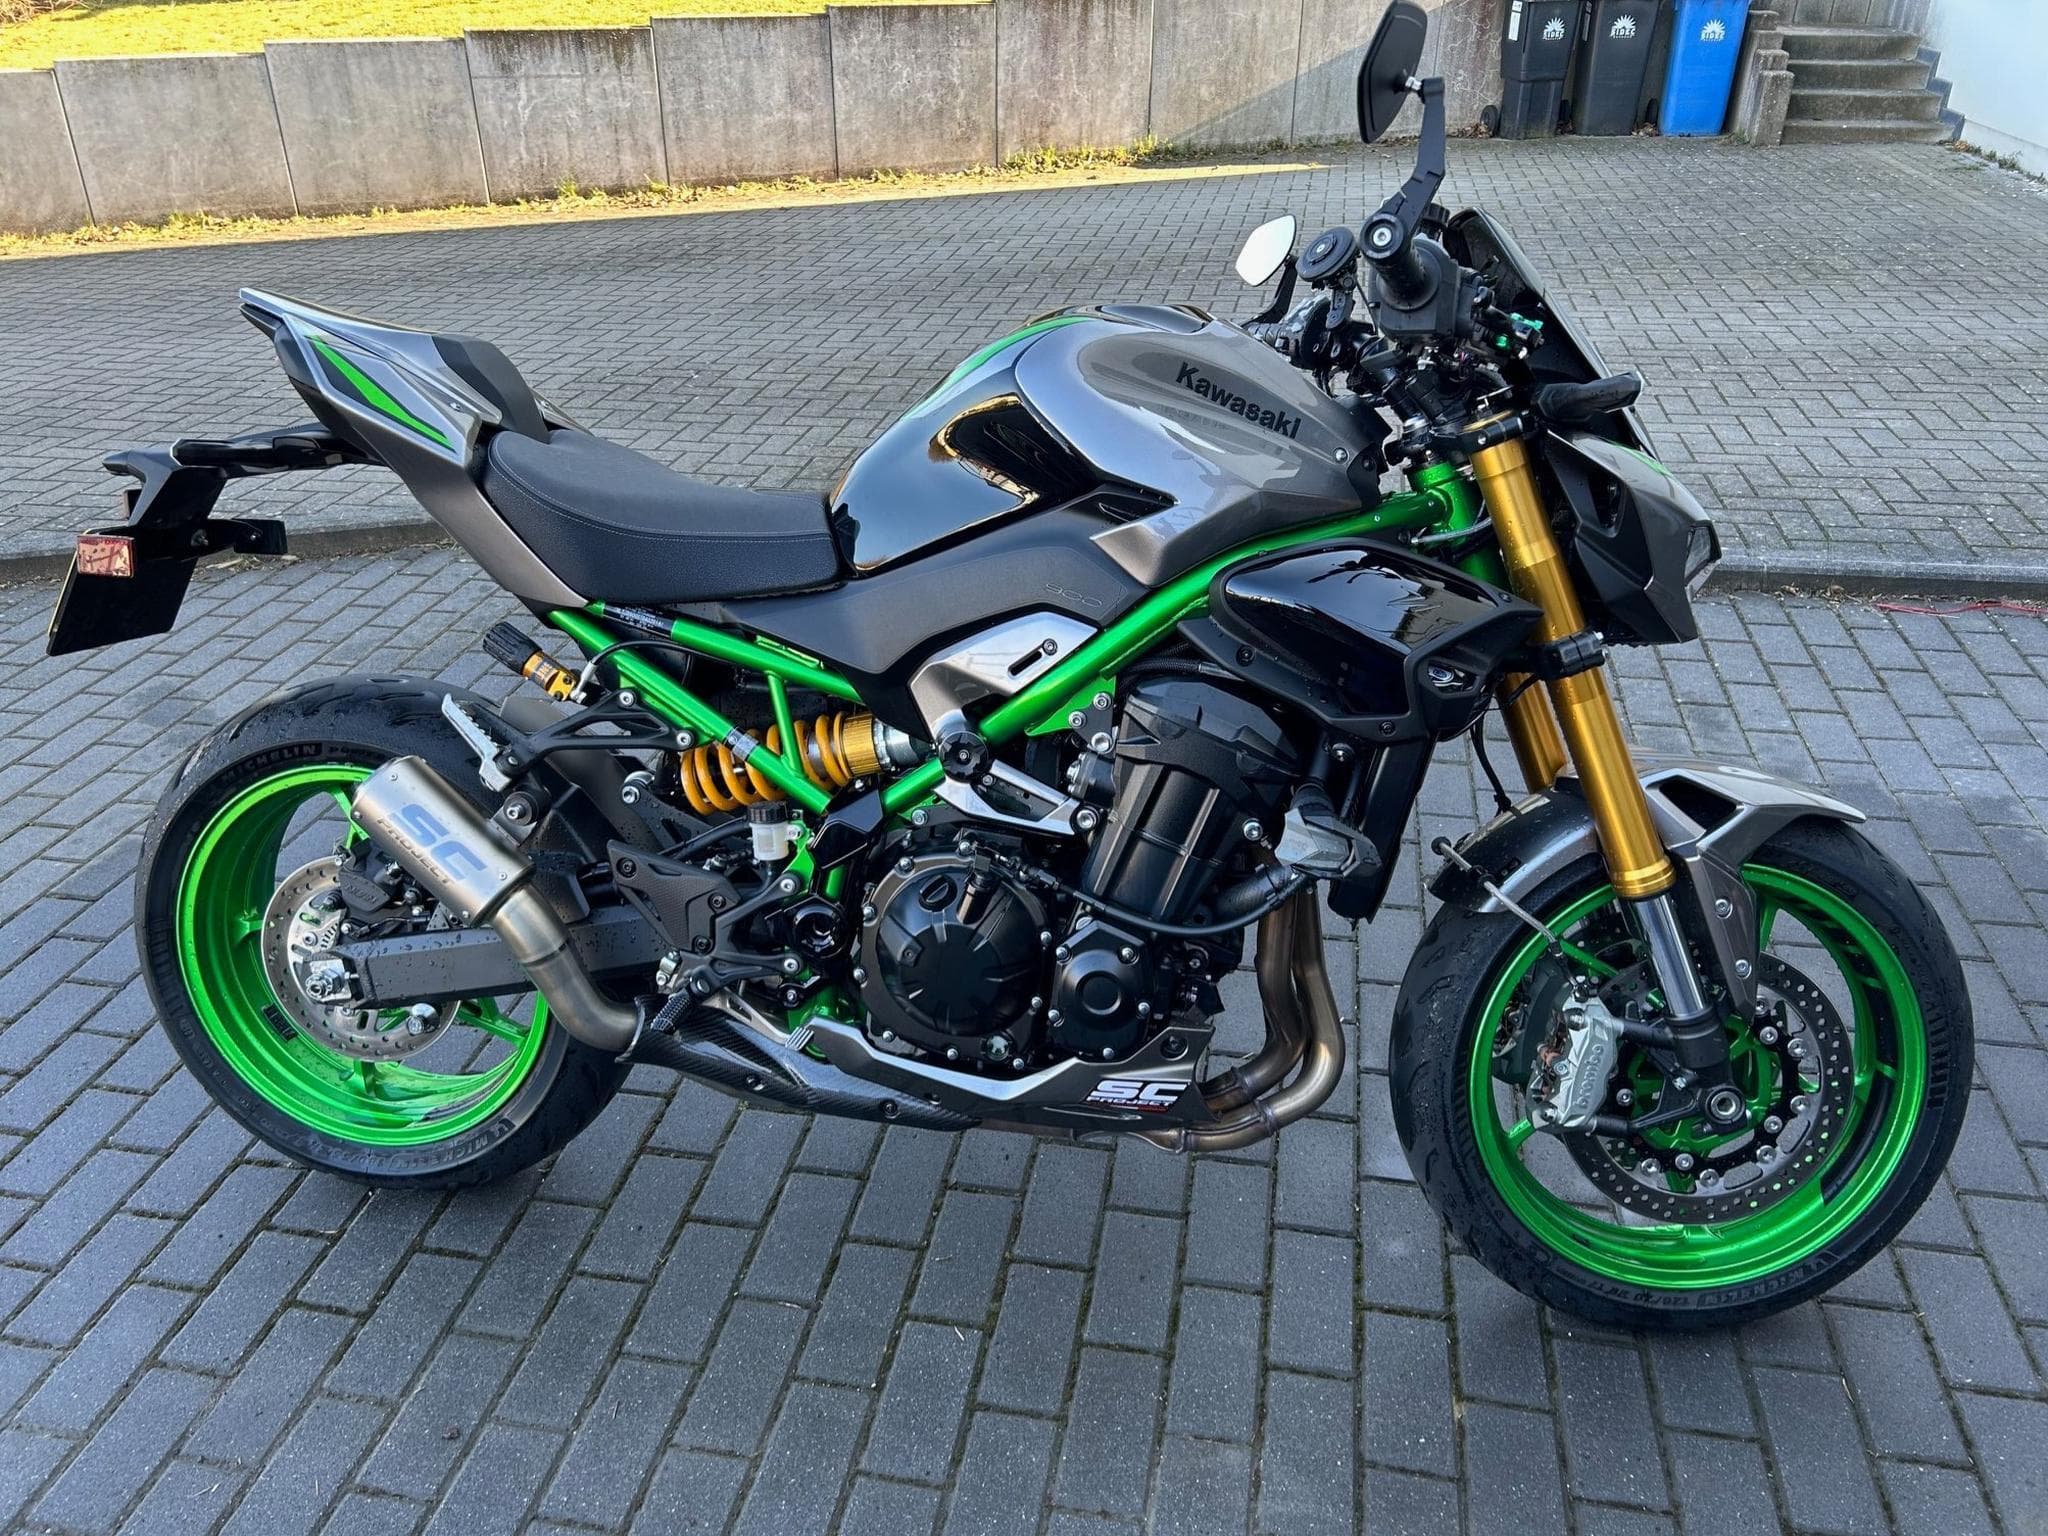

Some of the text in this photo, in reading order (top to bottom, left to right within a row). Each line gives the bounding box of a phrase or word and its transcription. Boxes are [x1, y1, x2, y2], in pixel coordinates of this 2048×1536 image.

[1175, 361, 1302, 440] Kawasaki
[220, 740, 318, 790] MICHELIN
[377, 817, 451, 884] PROJECT
[386, 803, 489, 881] SC
[1086, 1095, 1174, 1107] PROJECT
[1090, 1079, 1188, 1101] SC
[1572, 1044, 1605, 1108] brembo
